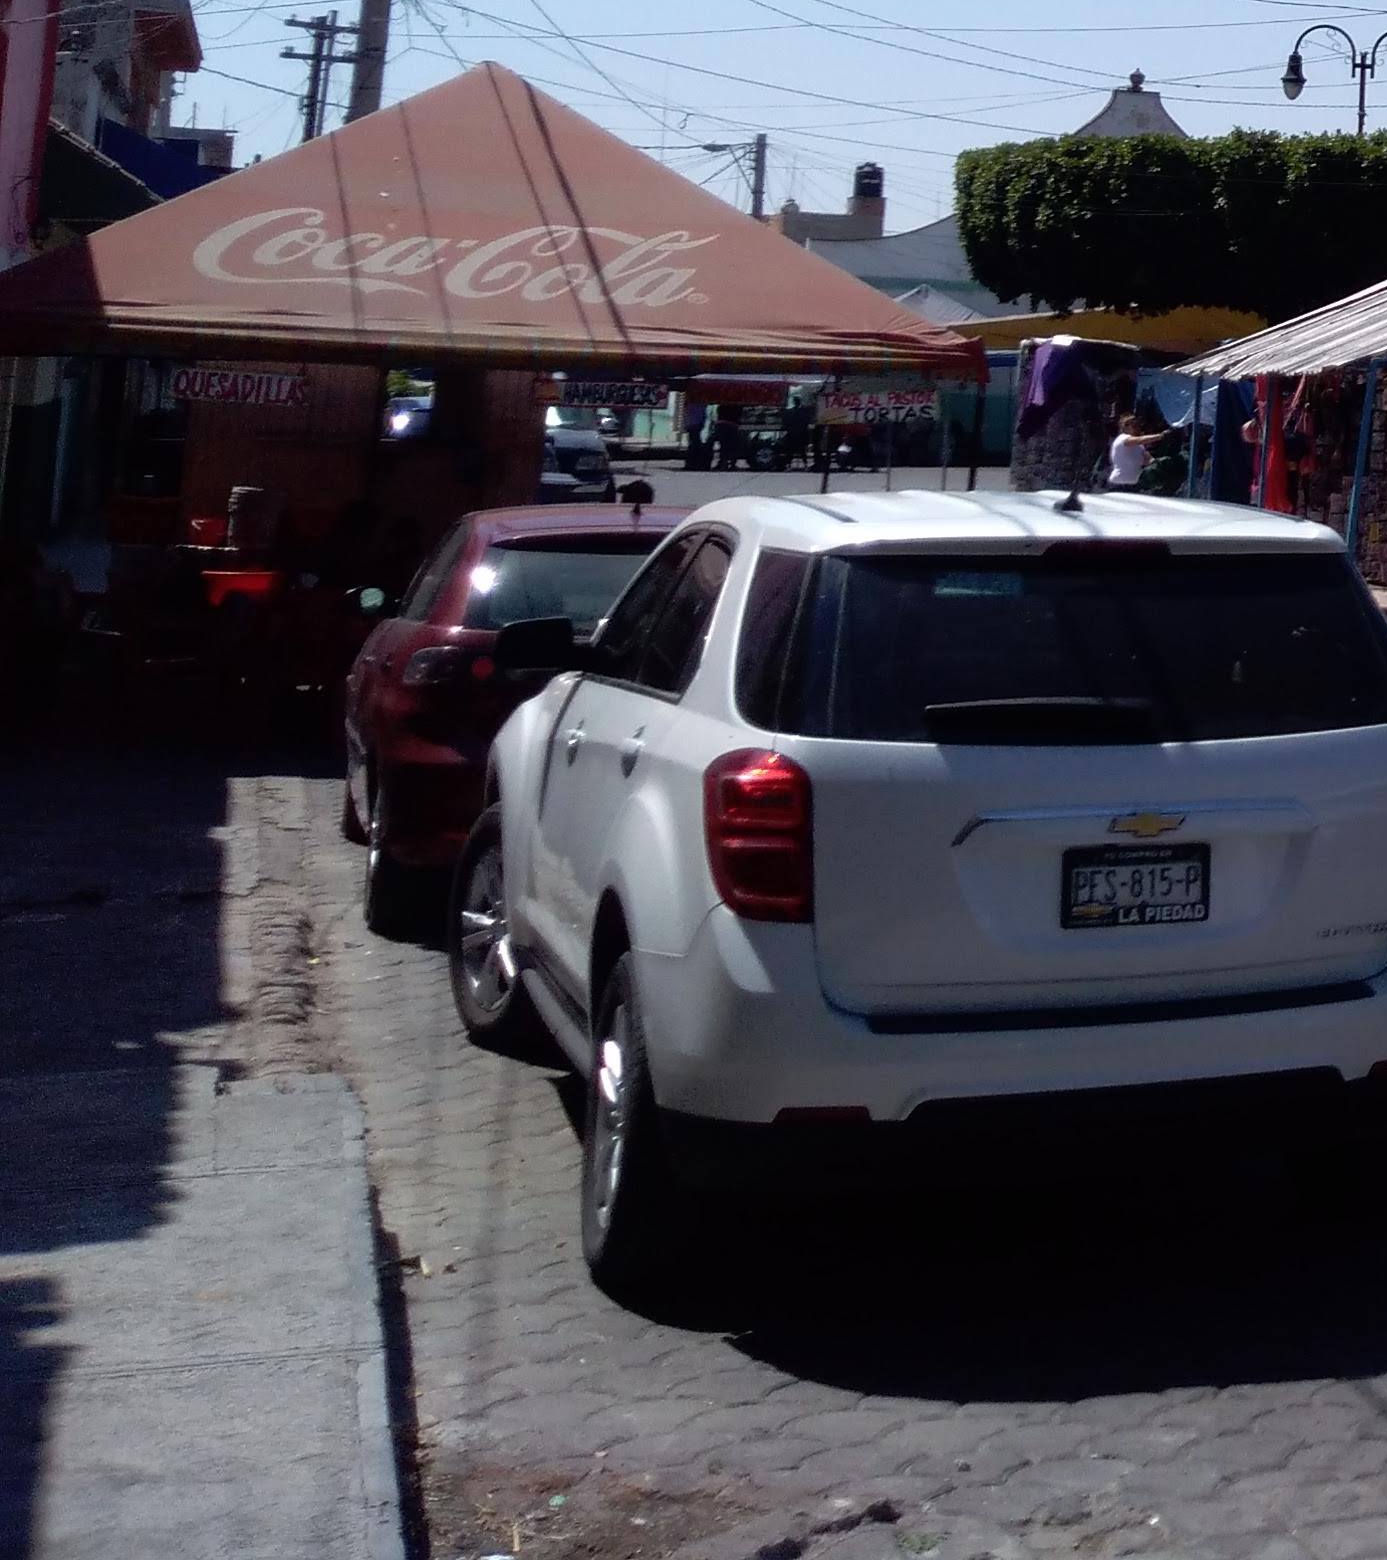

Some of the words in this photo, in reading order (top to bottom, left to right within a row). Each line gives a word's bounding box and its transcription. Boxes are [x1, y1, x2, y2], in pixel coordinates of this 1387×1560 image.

[193, 207, 720, 308] Coca-Cola
[848, 405, 936, 425] TORTAS
[1074, 864, 1201, 902] PES-815-P
[1118, 906, 1141, 924] LA
[1144, 903, 1206, 923] PIEDAD
